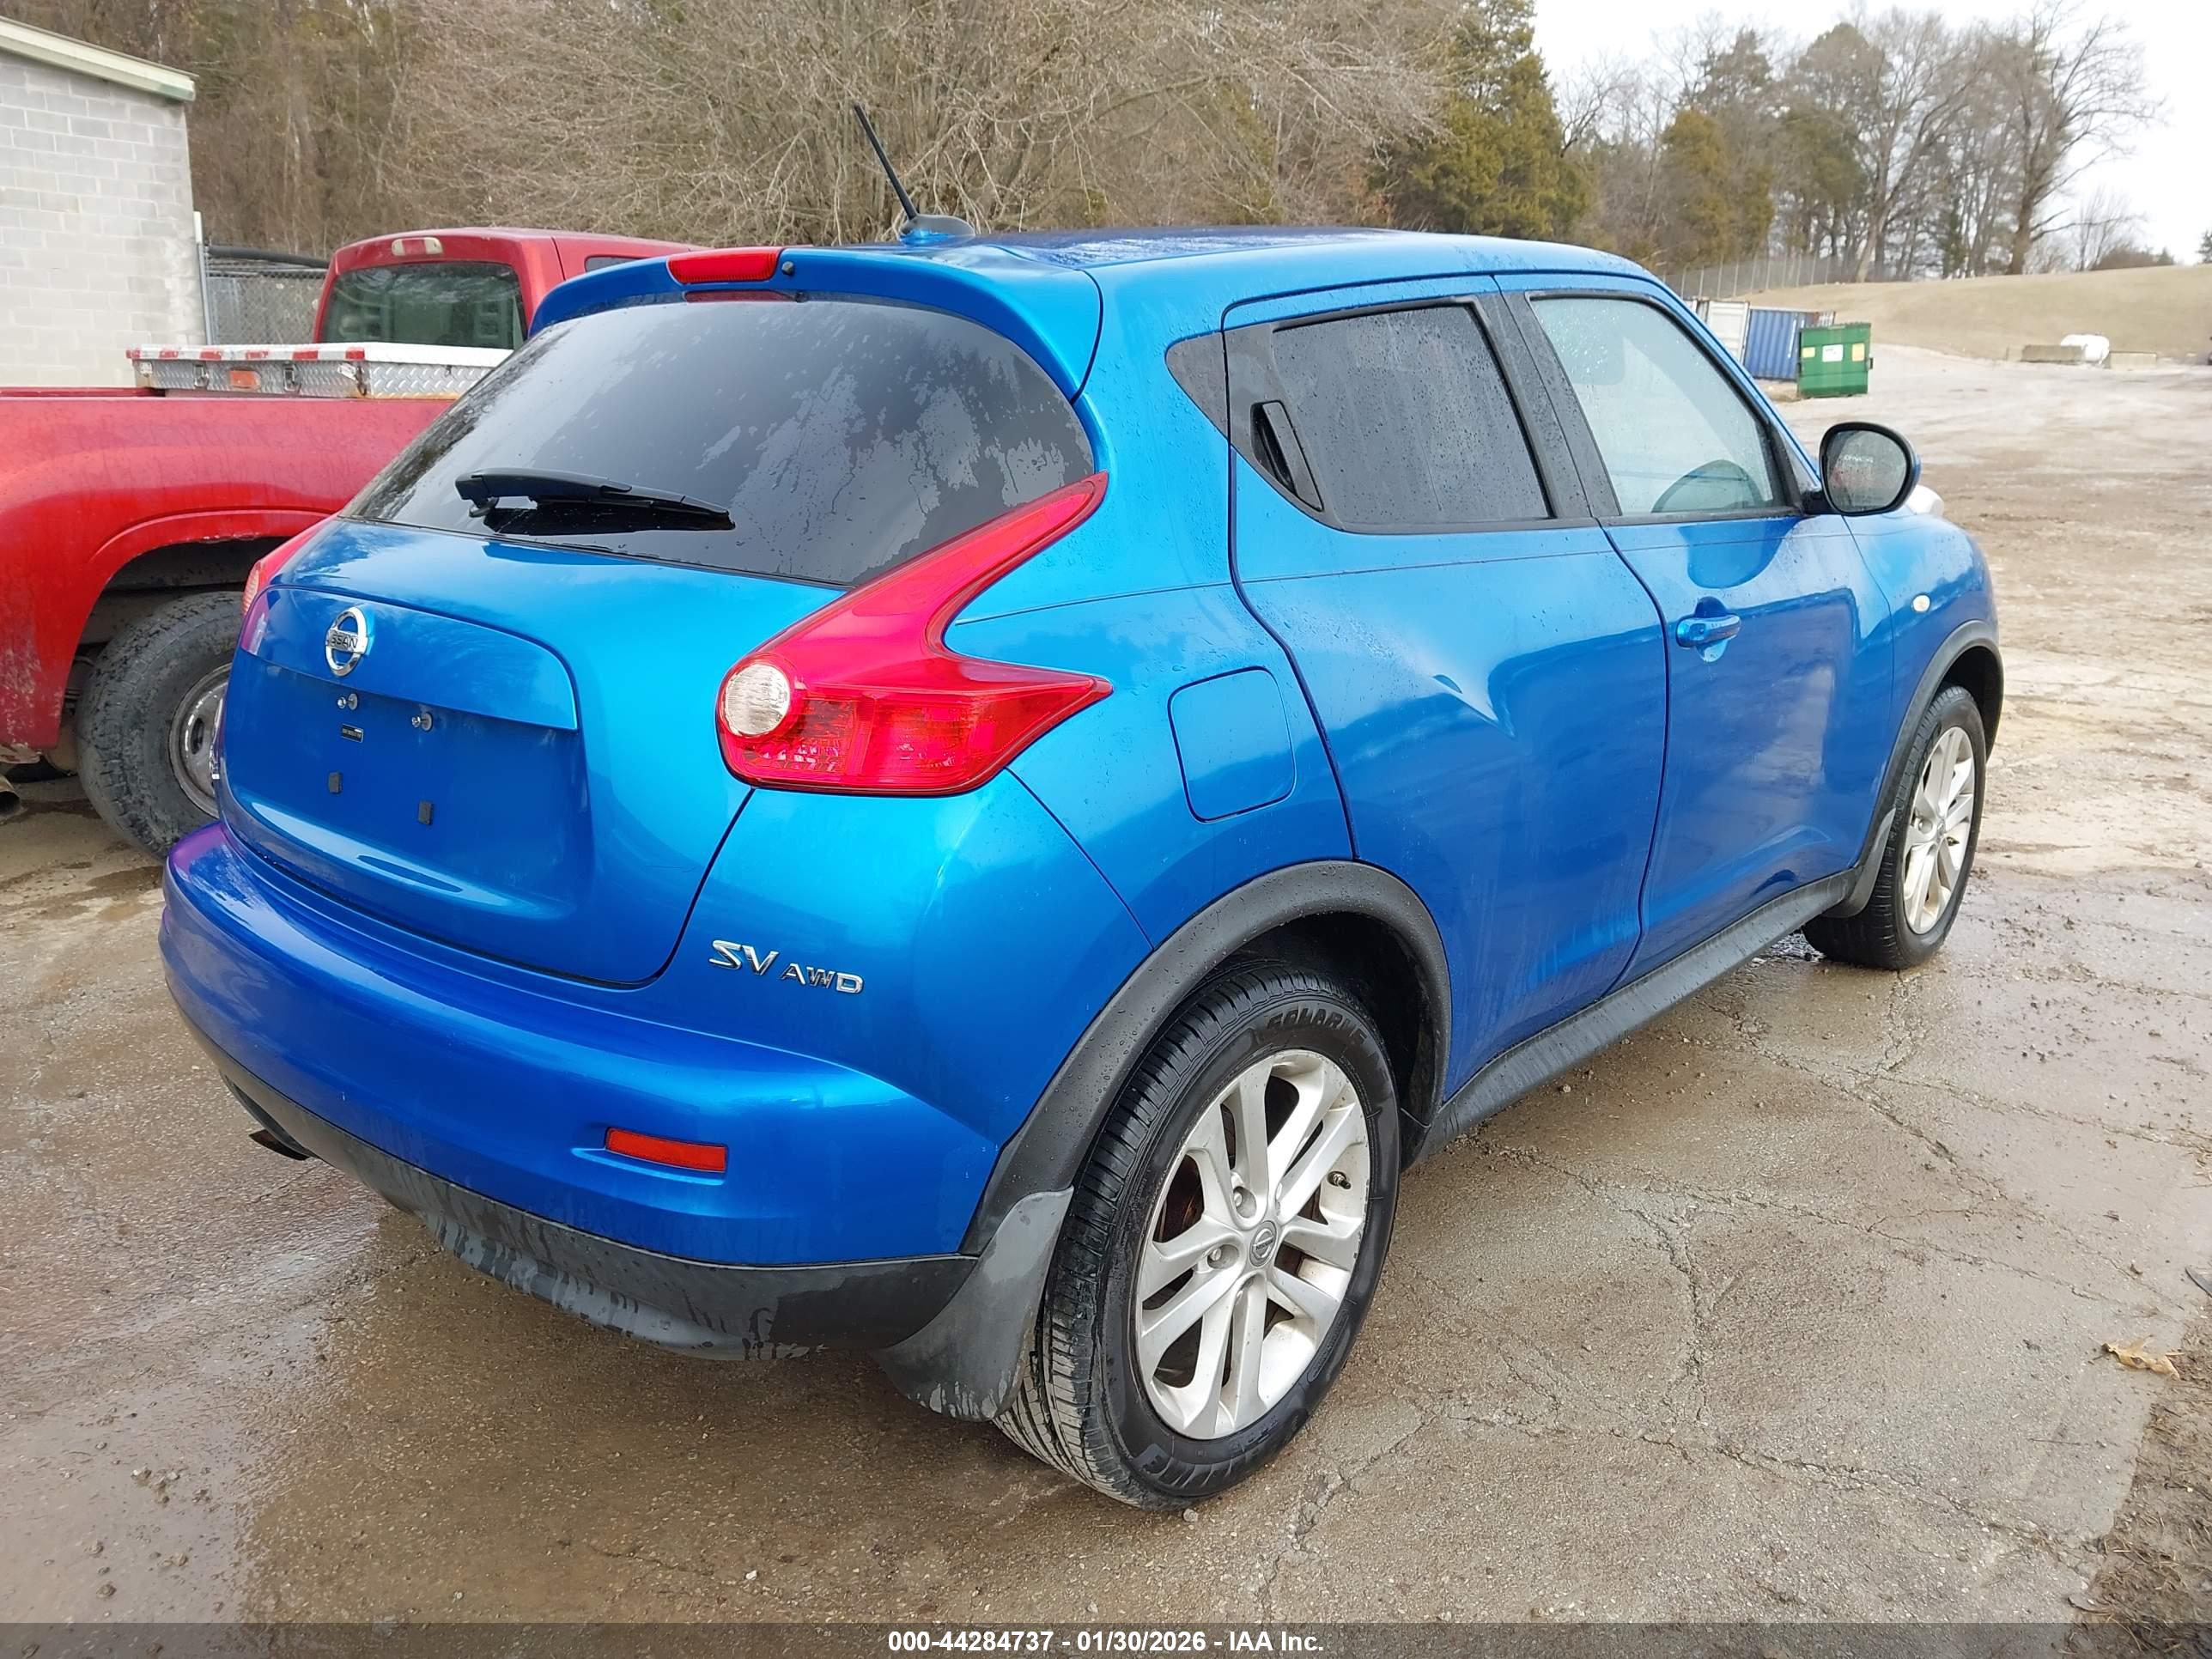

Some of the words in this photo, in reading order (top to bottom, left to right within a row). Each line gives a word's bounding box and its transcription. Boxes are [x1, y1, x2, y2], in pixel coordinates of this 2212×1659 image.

[327, 629, 359, 650] SSAN
[708, 939, 779, 976] SV
[779, 962, 865, 994] AWD
